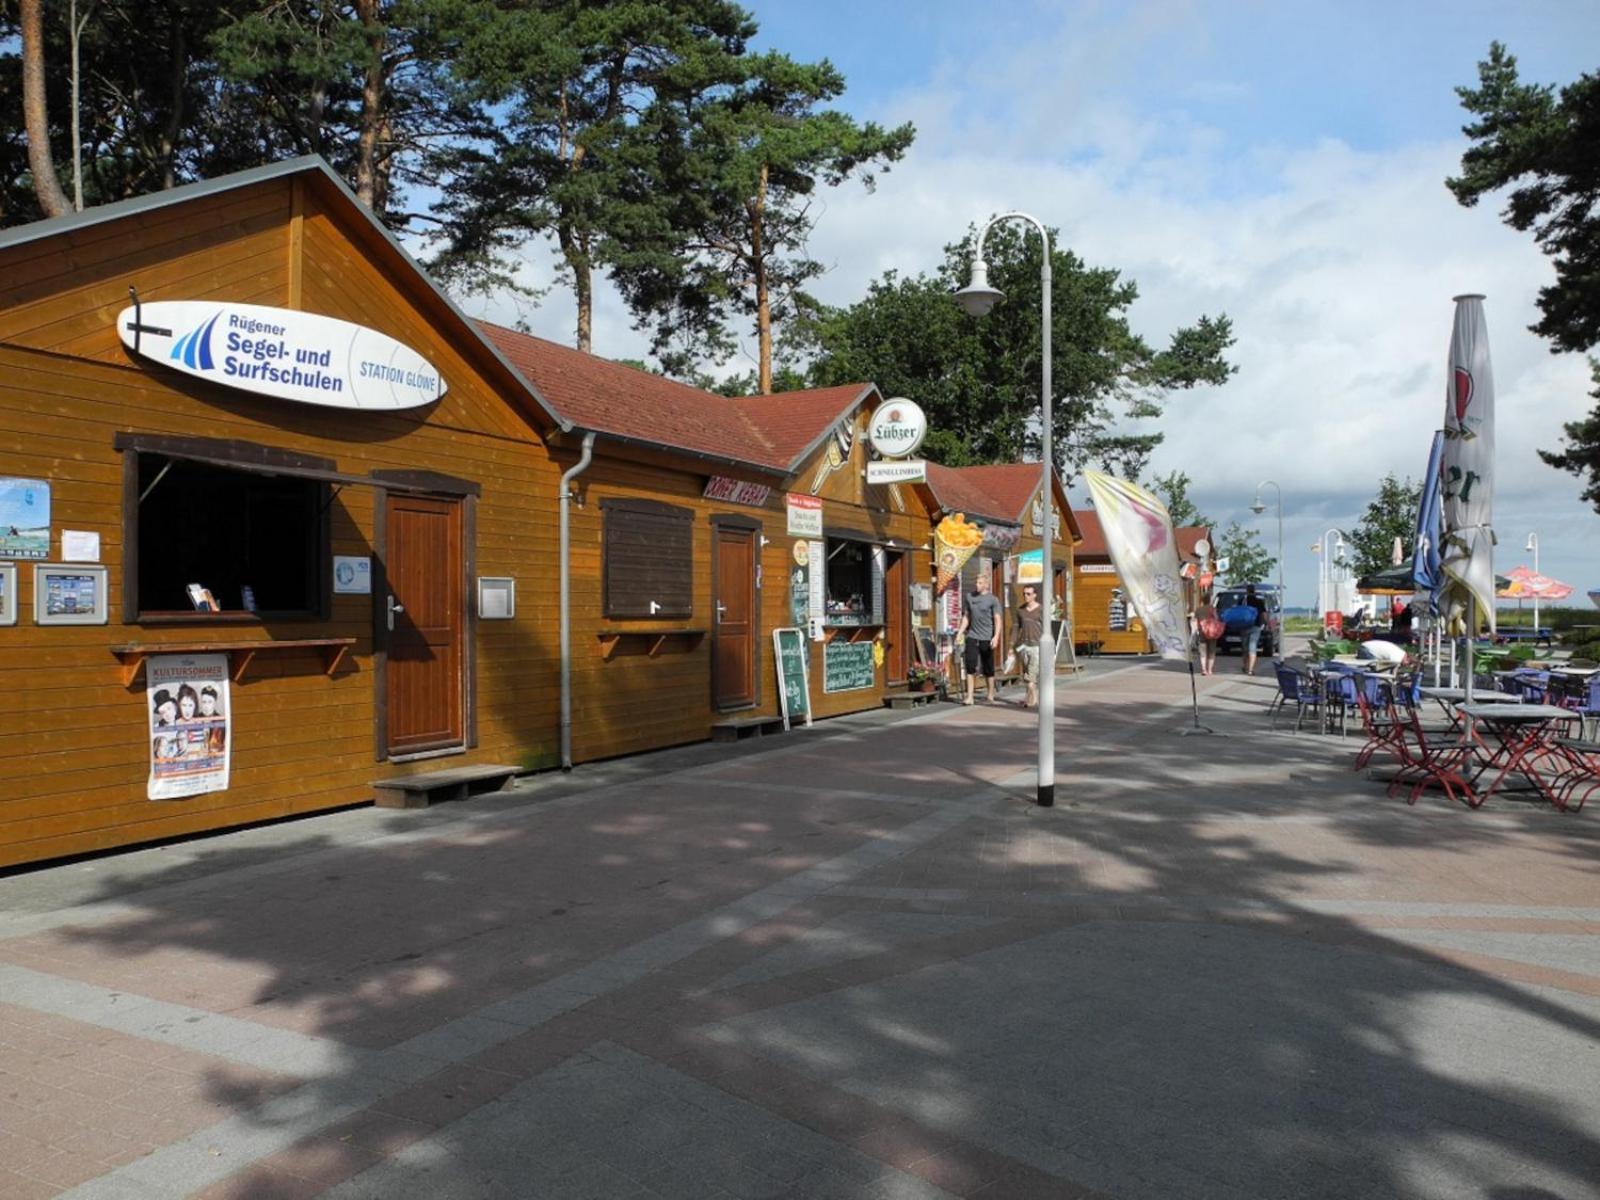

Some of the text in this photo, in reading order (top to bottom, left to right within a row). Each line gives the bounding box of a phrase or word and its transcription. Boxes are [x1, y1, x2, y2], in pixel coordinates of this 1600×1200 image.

[229, 314, 286, 336] Rügener
[226, 332, 331, 367] Segel- und
[223, 355, 343, 392] Surfschulen
[360, 361, 436, 392] STATION GLOWE
[874, 425, 917, 440] Lübzer
[153, 665, 223, 676] KULTURSOMMER
